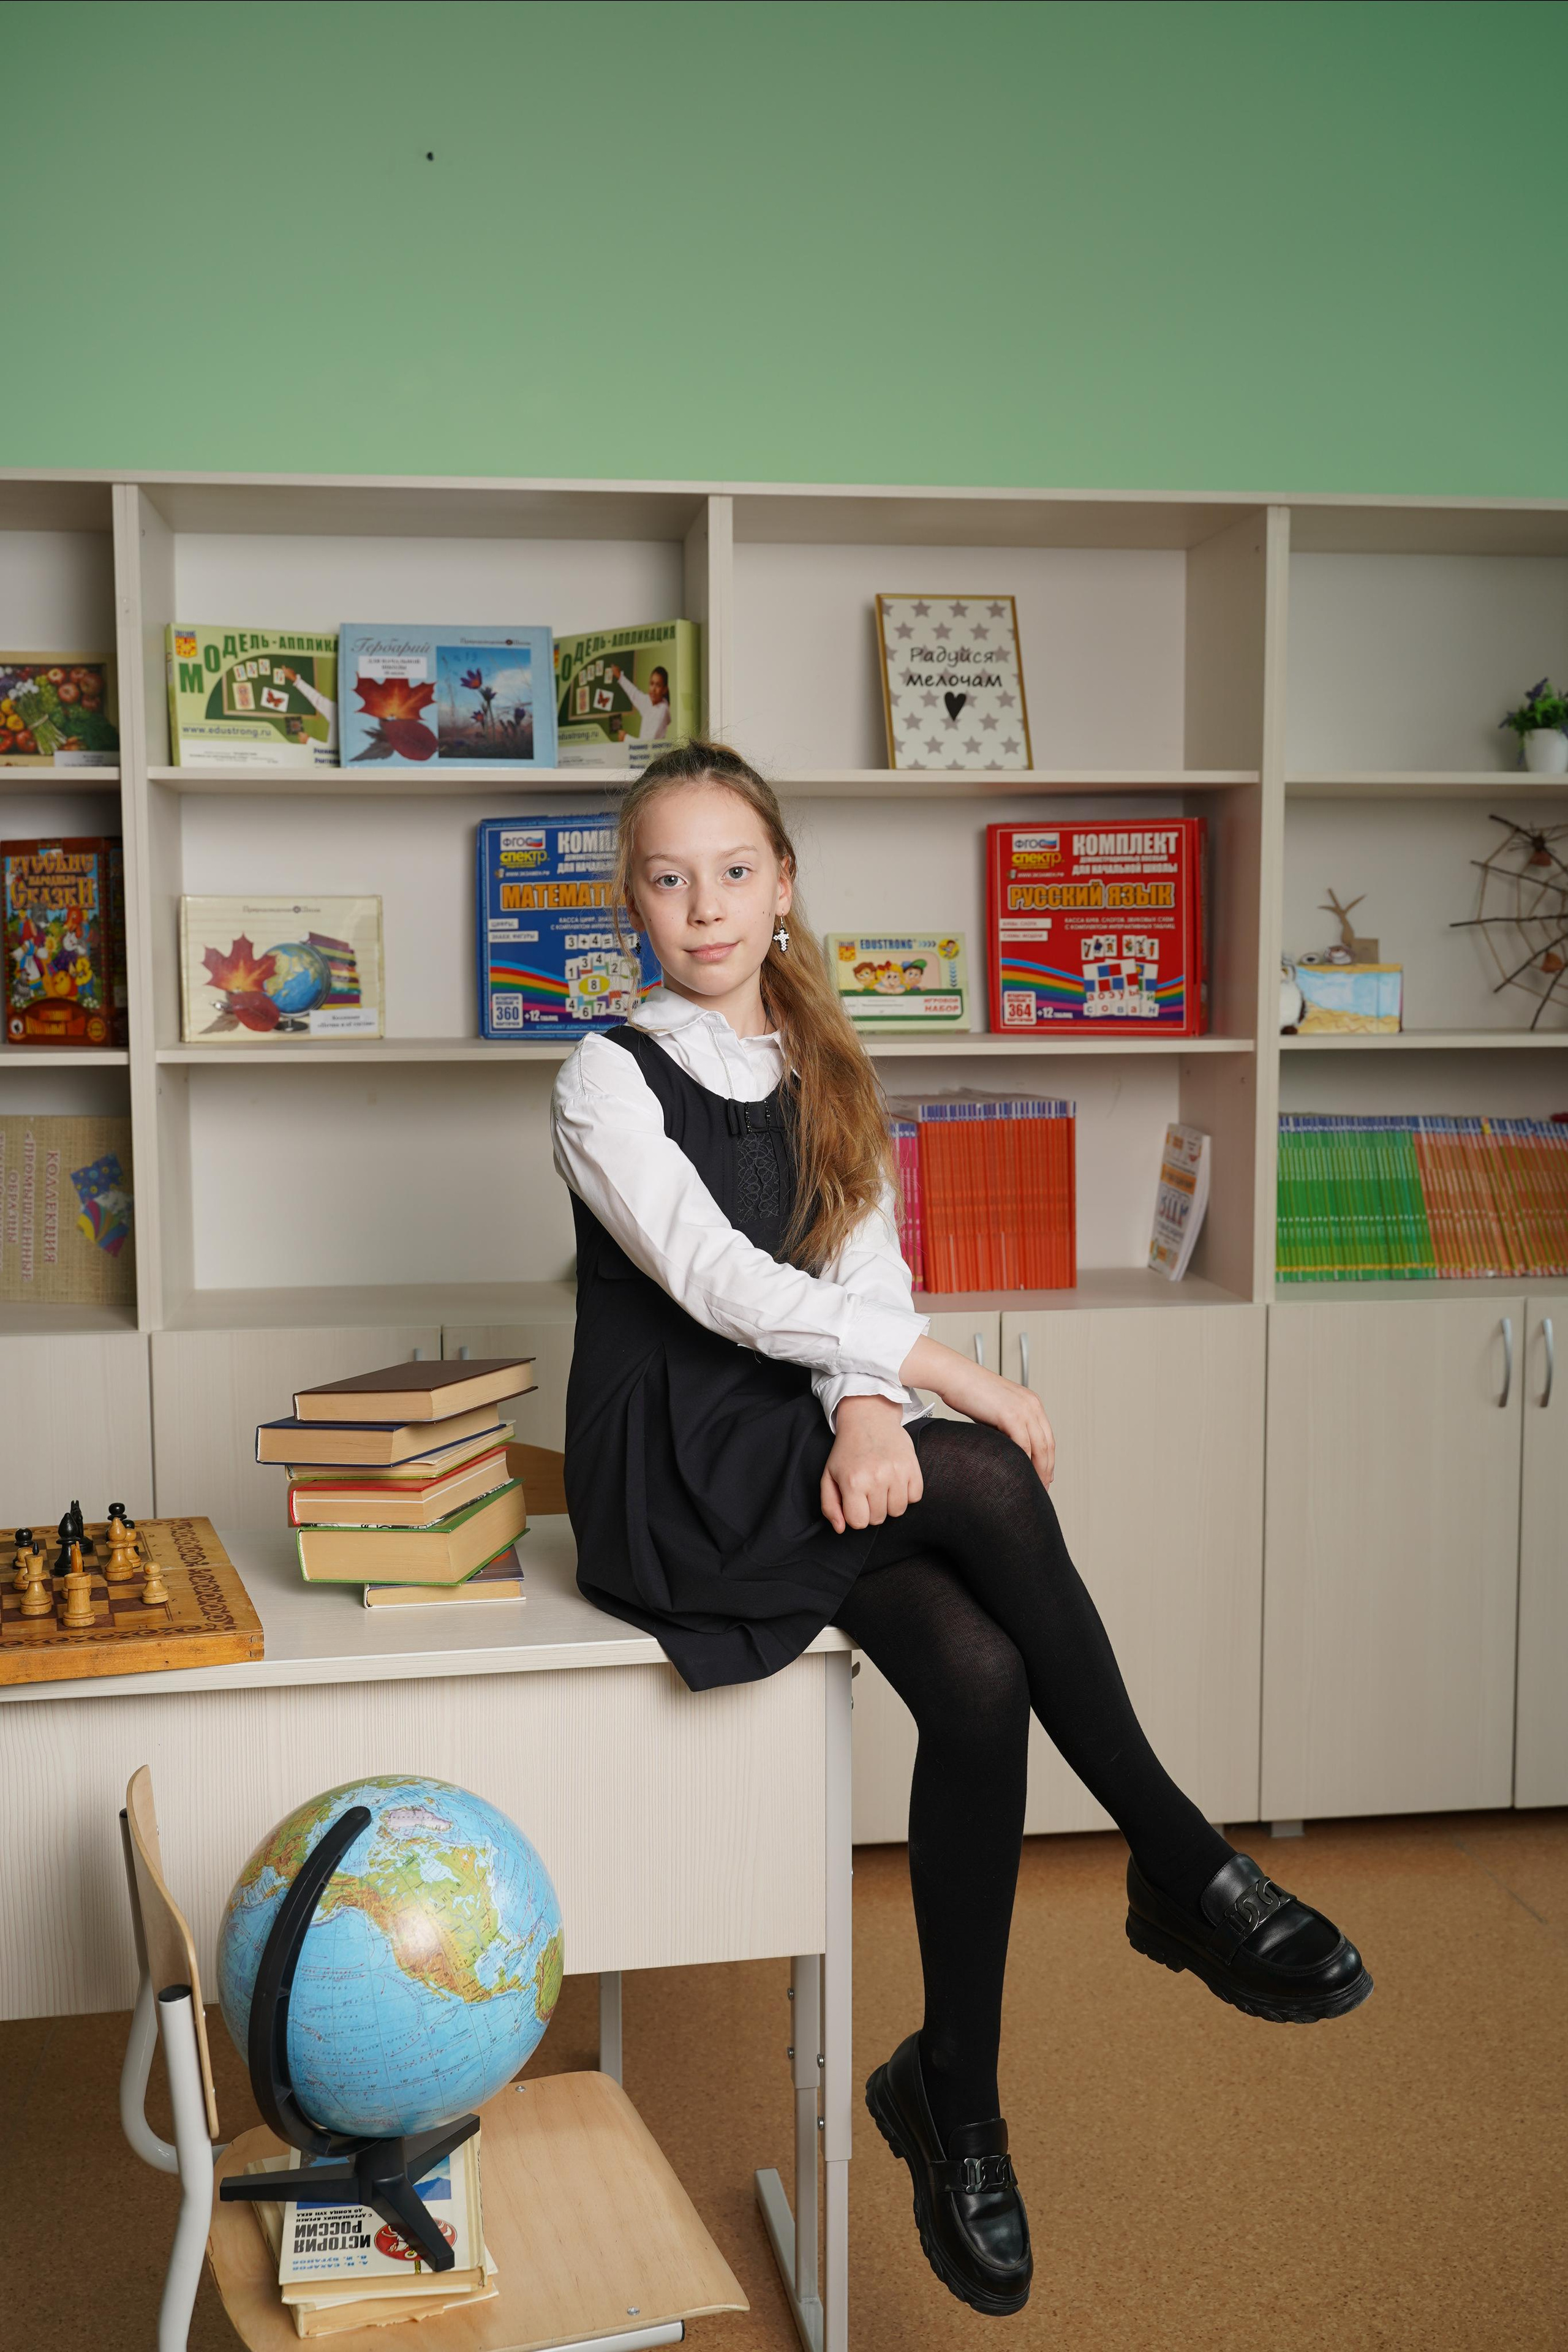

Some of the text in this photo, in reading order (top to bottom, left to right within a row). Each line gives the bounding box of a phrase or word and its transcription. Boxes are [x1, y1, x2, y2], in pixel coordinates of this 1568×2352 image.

[556, 625, 676, 703] ОДЕЛЬ-АППЛИКАЦИЯ
[910, 645, 994, 668] Радуйся
[183, 726, 271, 737] www.edustrong.ru
[1072, 832, 1178, 856] КОМПЛЕКТ
[1010, 881, 1172, 908] РУССКИЙ ЯЗЫК
[568, 938, 575, 947] 3
[592, 935, 598, 944] 4
[860, 939, 913, 950] EDUSTRONG
[582, 954, 602, 968] 3 4
[568, 963, 618, 977] 1 2
[591, 980, 597, 990] 8
[497, 1006, 519, 1020] 360
[568, 1000, 621, 1017] 4 6 7 5
[1009, 1004, 1032, 1017] 364
[45, 1150, 58, 1264] КОЛЛЕКЦИЯ
[295, 2220, 362, 2238] РОССИИ
[294, 2234, 371, 2253] ИСТОРИЯ
